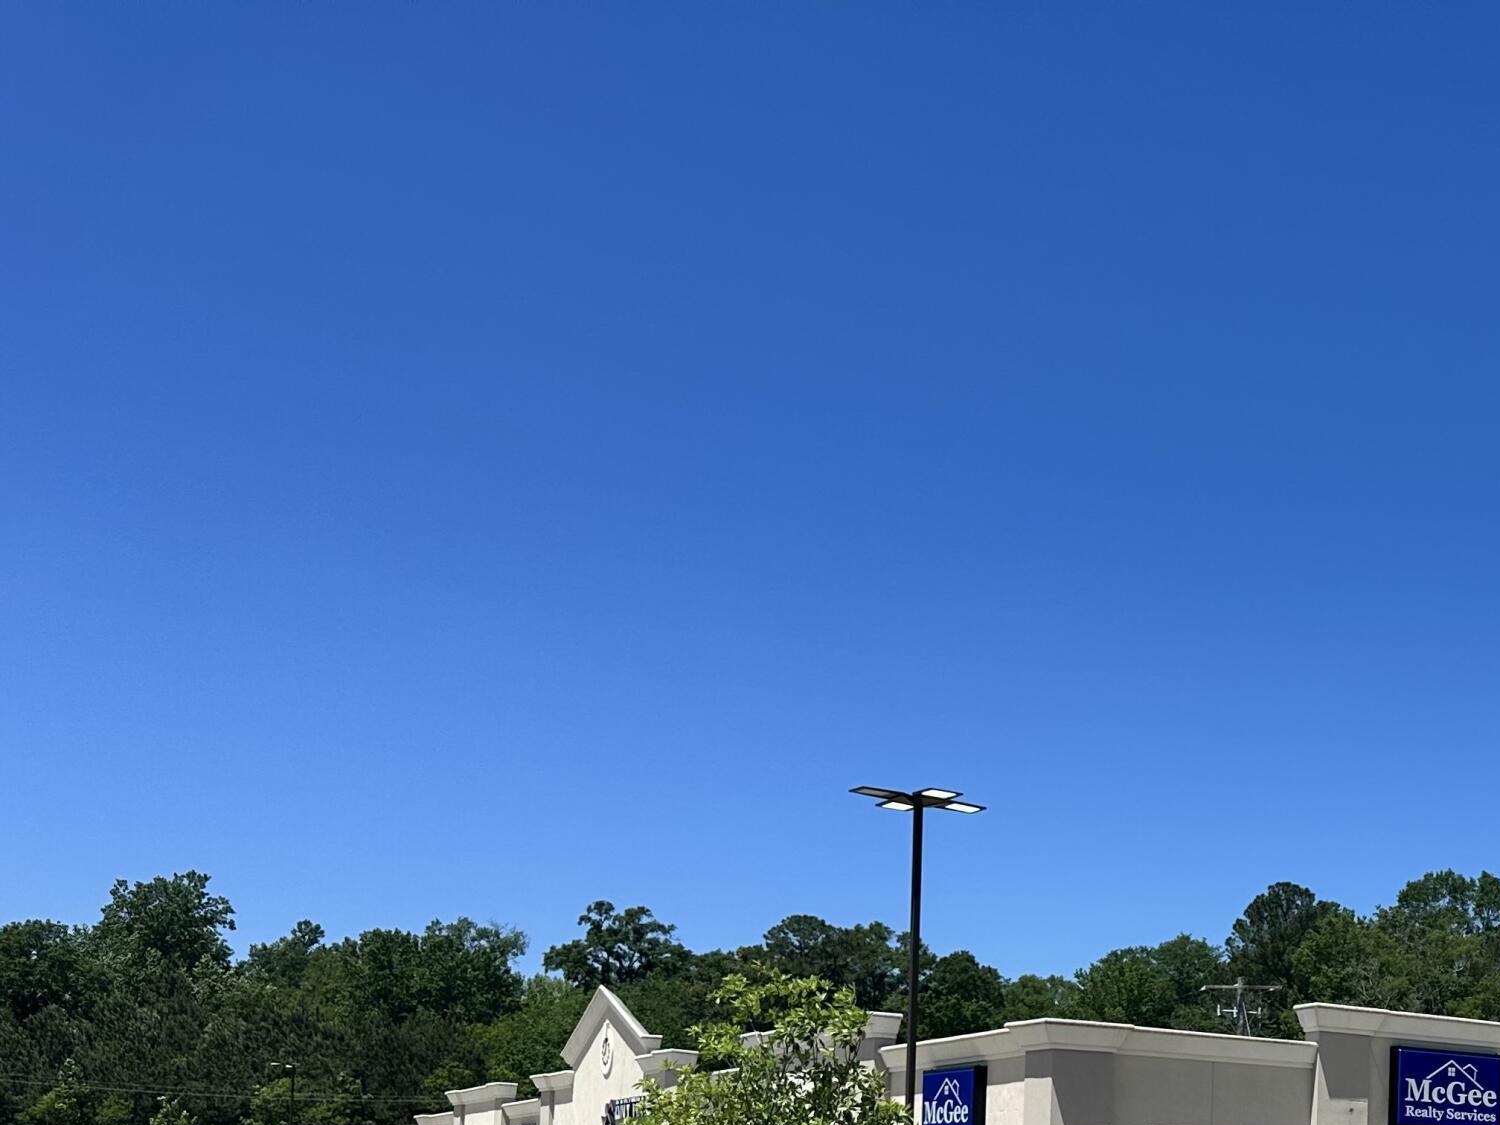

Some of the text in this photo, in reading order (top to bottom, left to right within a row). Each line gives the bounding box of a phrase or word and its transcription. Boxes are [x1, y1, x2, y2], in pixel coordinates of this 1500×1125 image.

[1404, 1077, 1498, 1108] McGee
[923, 1099, 969, 1125] McGee
[1404, 1105, 1497, 1123] Realty Services
